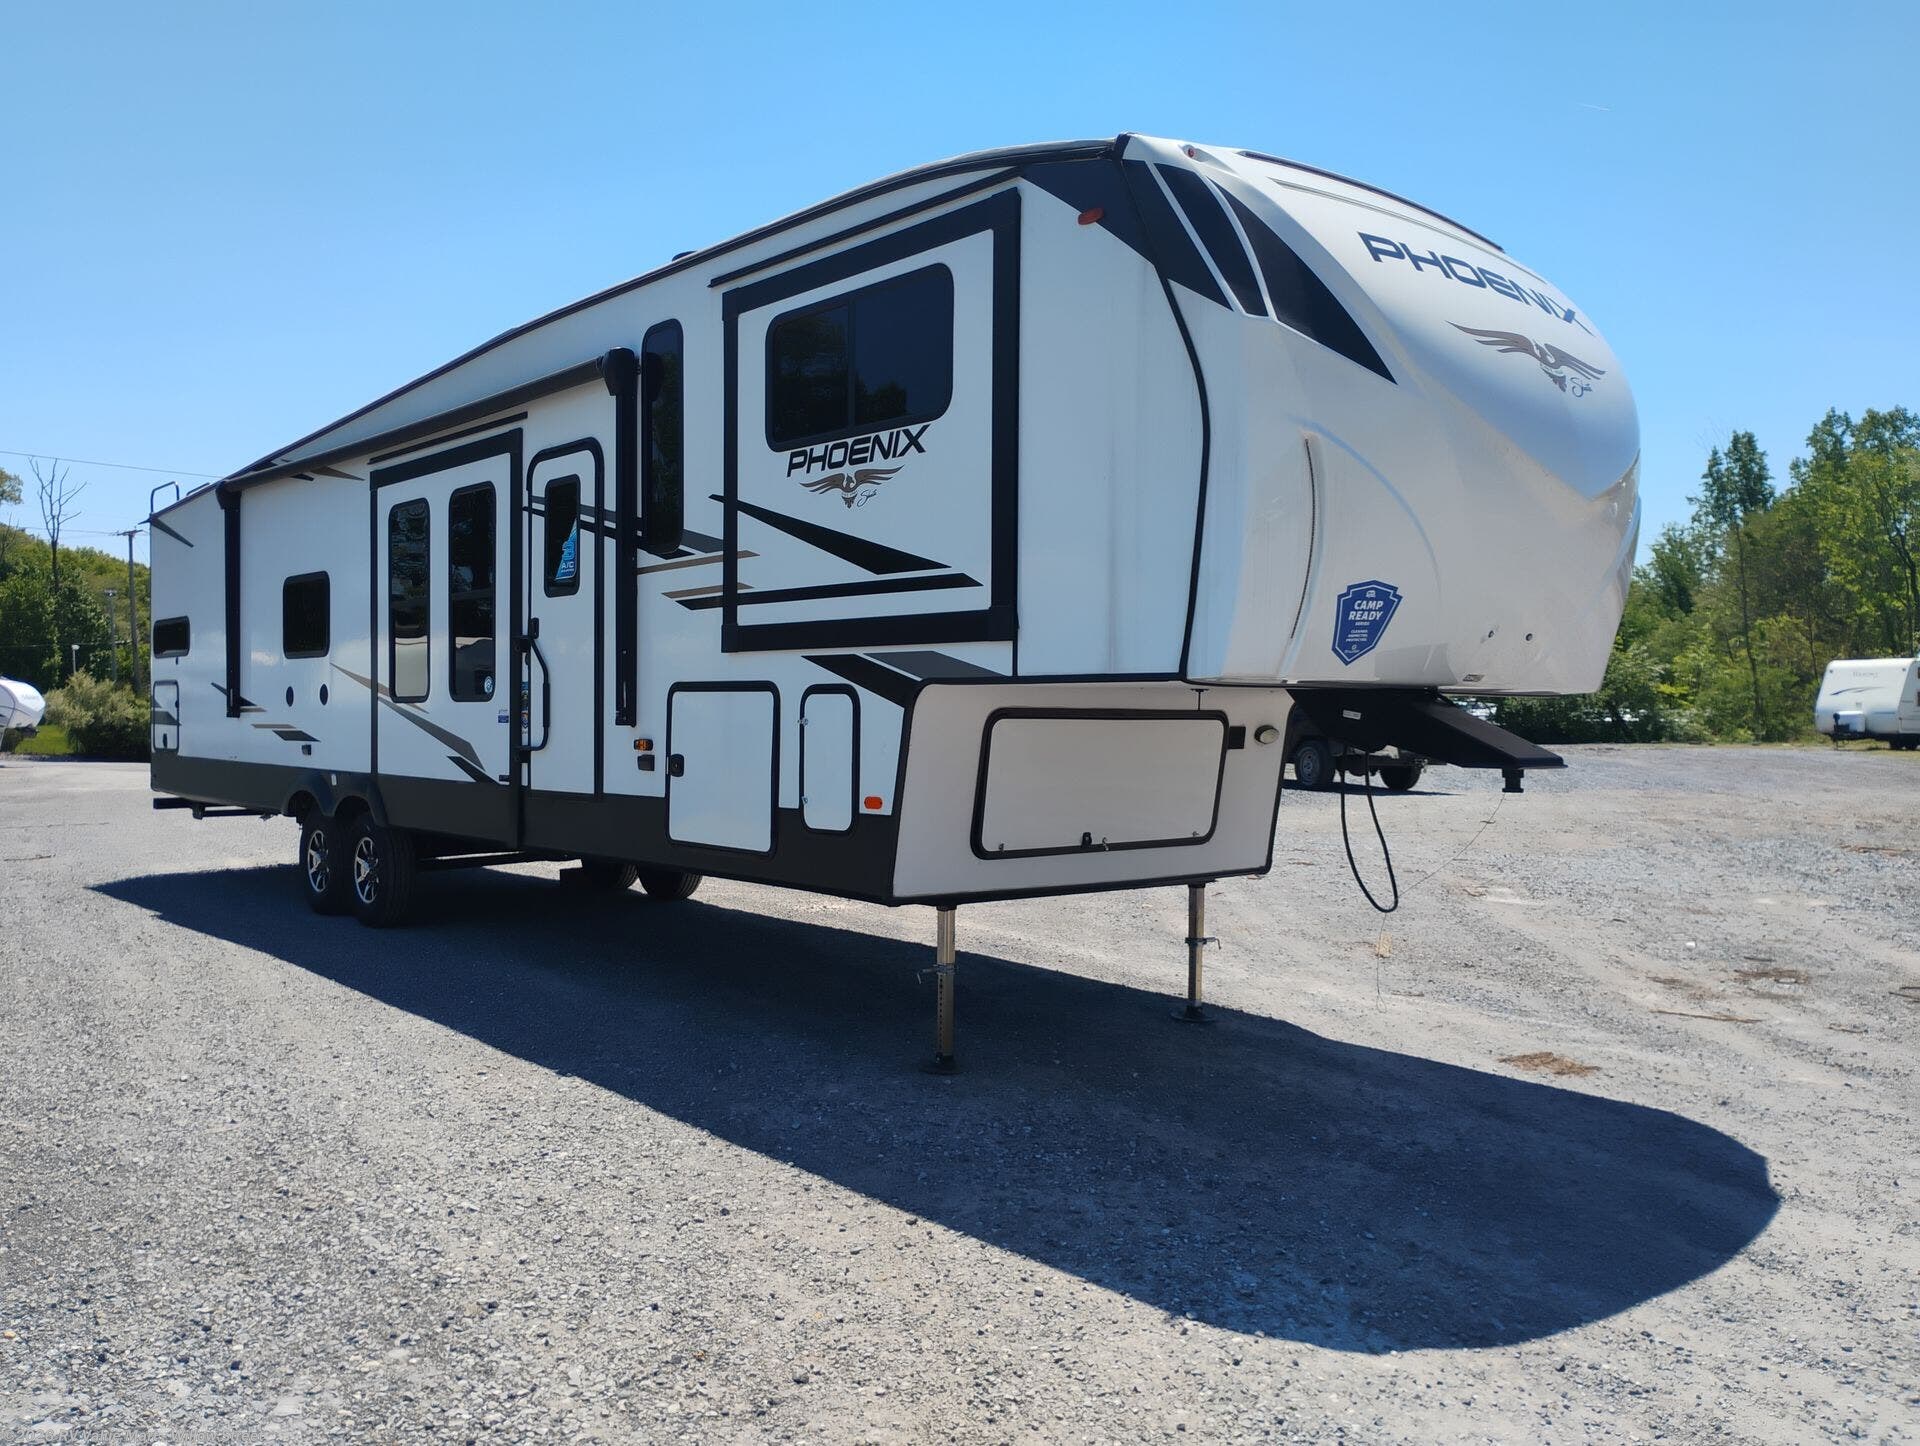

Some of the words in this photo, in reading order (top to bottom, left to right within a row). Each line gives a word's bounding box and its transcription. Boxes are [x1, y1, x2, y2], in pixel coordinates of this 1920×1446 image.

[1357, 231, 1596, 337] PHOENIX
[786, 423, 931, 478] PHOENIX
[1348, 611, 1383, 620] READY
[1354, 600, 1383, 610] CAMP
